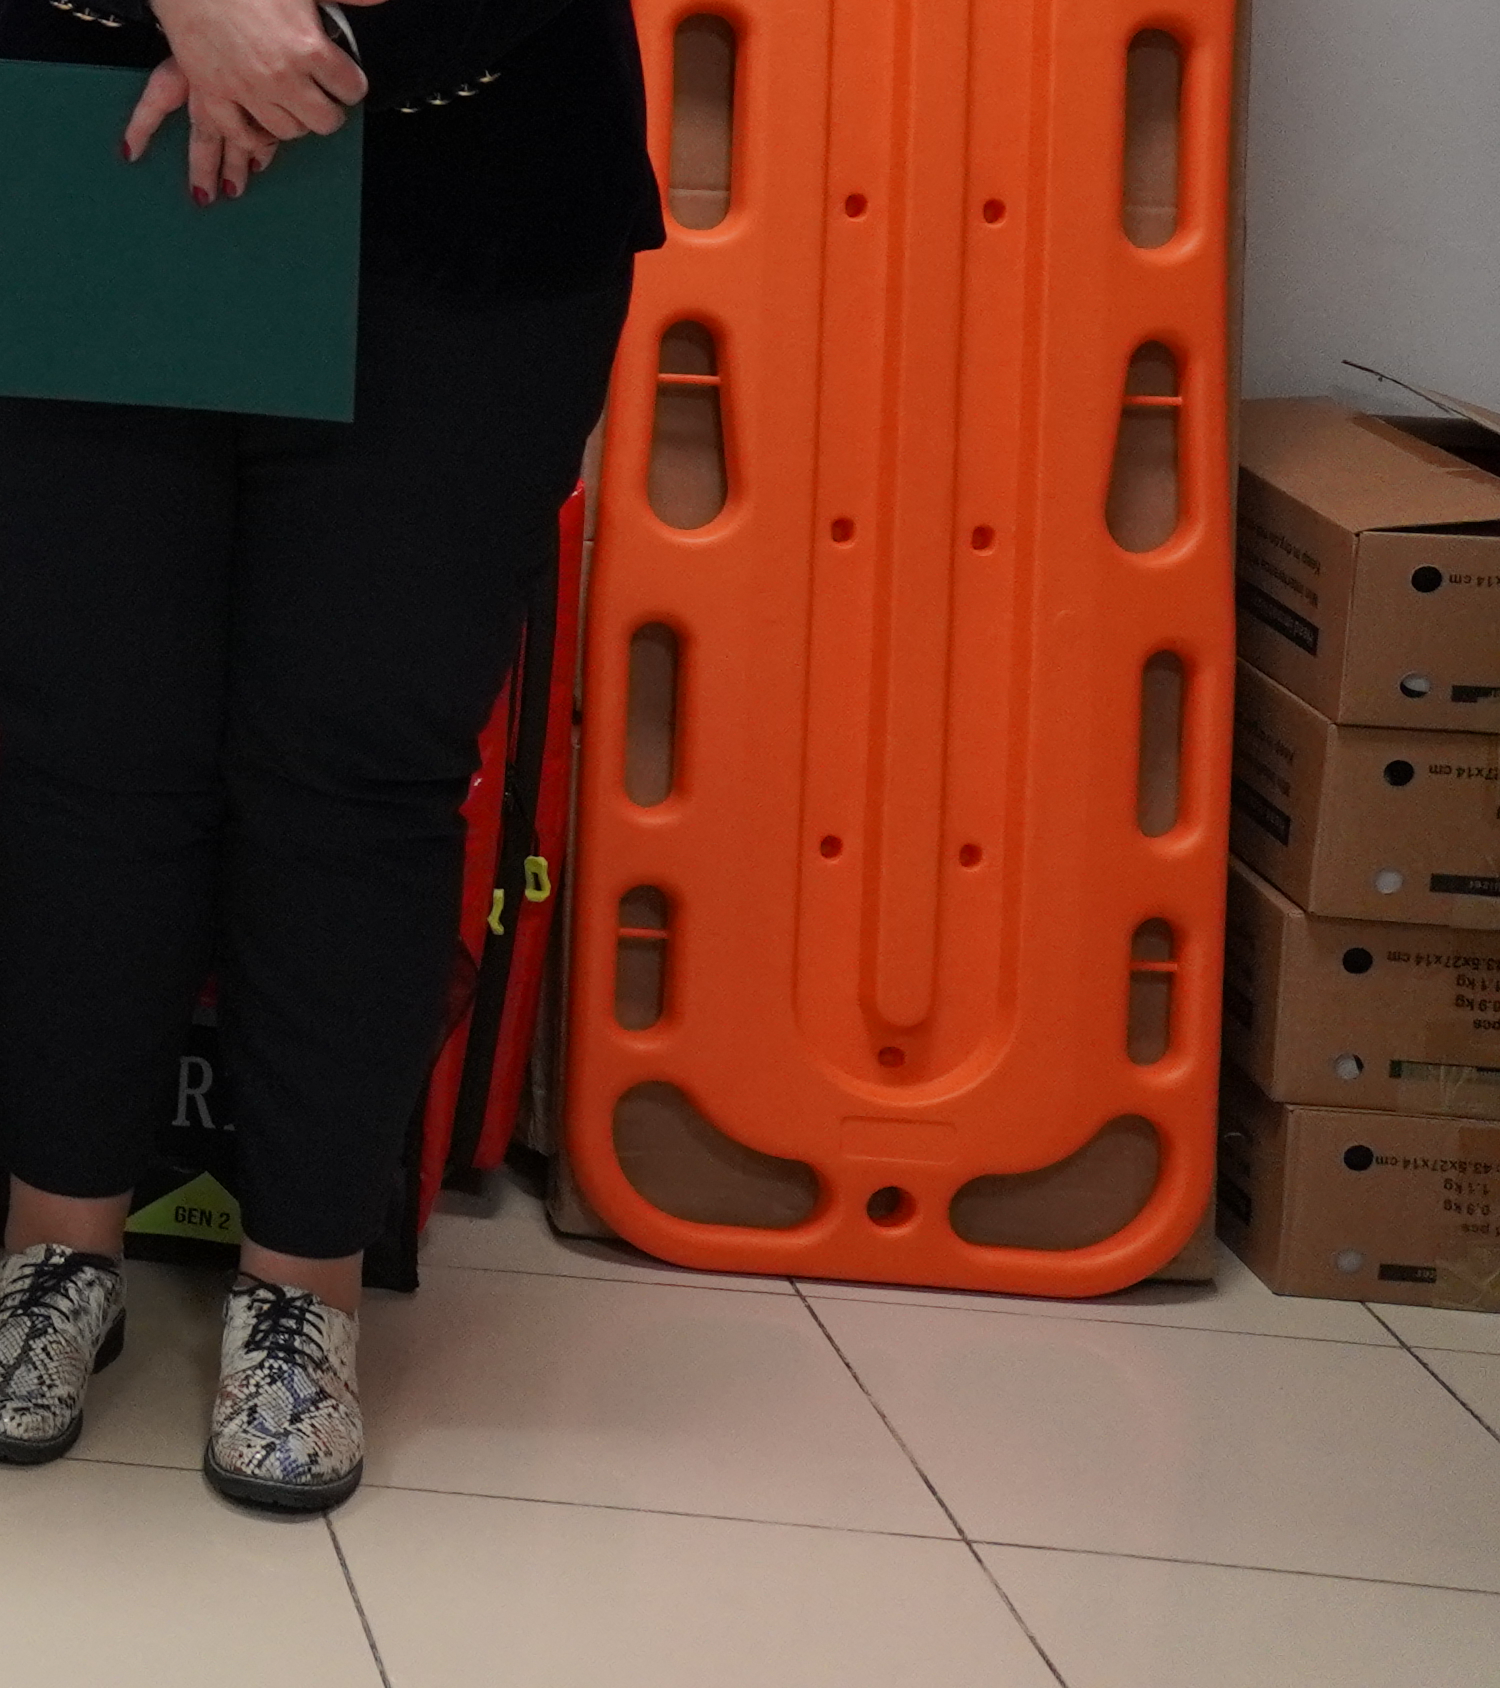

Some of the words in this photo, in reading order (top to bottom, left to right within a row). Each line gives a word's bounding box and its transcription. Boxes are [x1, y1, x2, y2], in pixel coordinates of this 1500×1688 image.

[172, 1056, 236, 1131] R
[174, 1205, 213, 1227] GEN
[219, 1212, 231, 1230] 2
